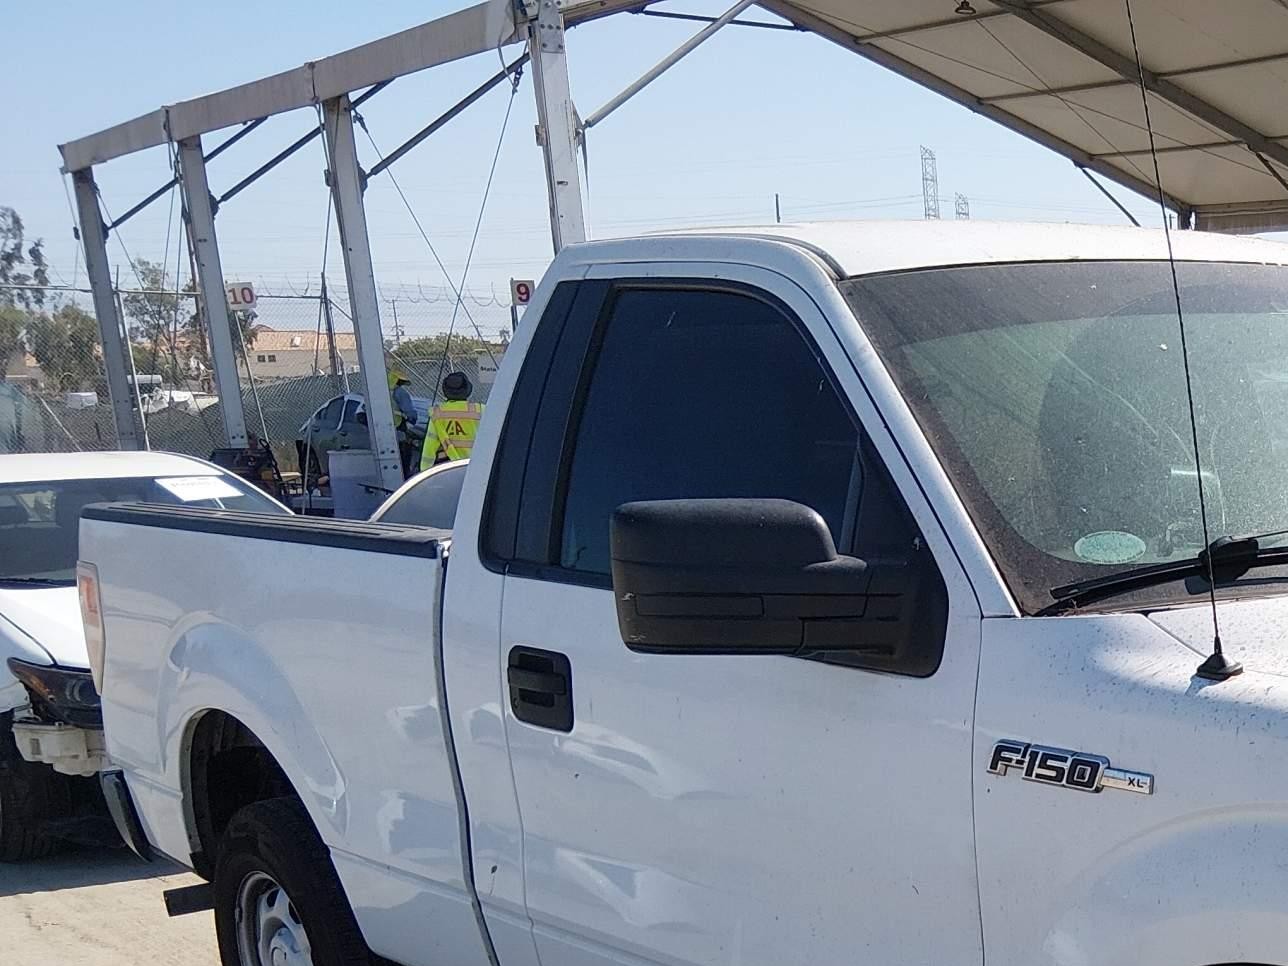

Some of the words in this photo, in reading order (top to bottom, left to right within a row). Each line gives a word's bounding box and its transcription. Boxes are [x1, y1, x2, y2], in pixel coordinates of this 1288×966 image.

[228, 287, 254, 304] 10
[516, 283, 530, 302] 9
[987, 740, 1106, 791] F-150
[1127, 776, 1144, 788] XL
